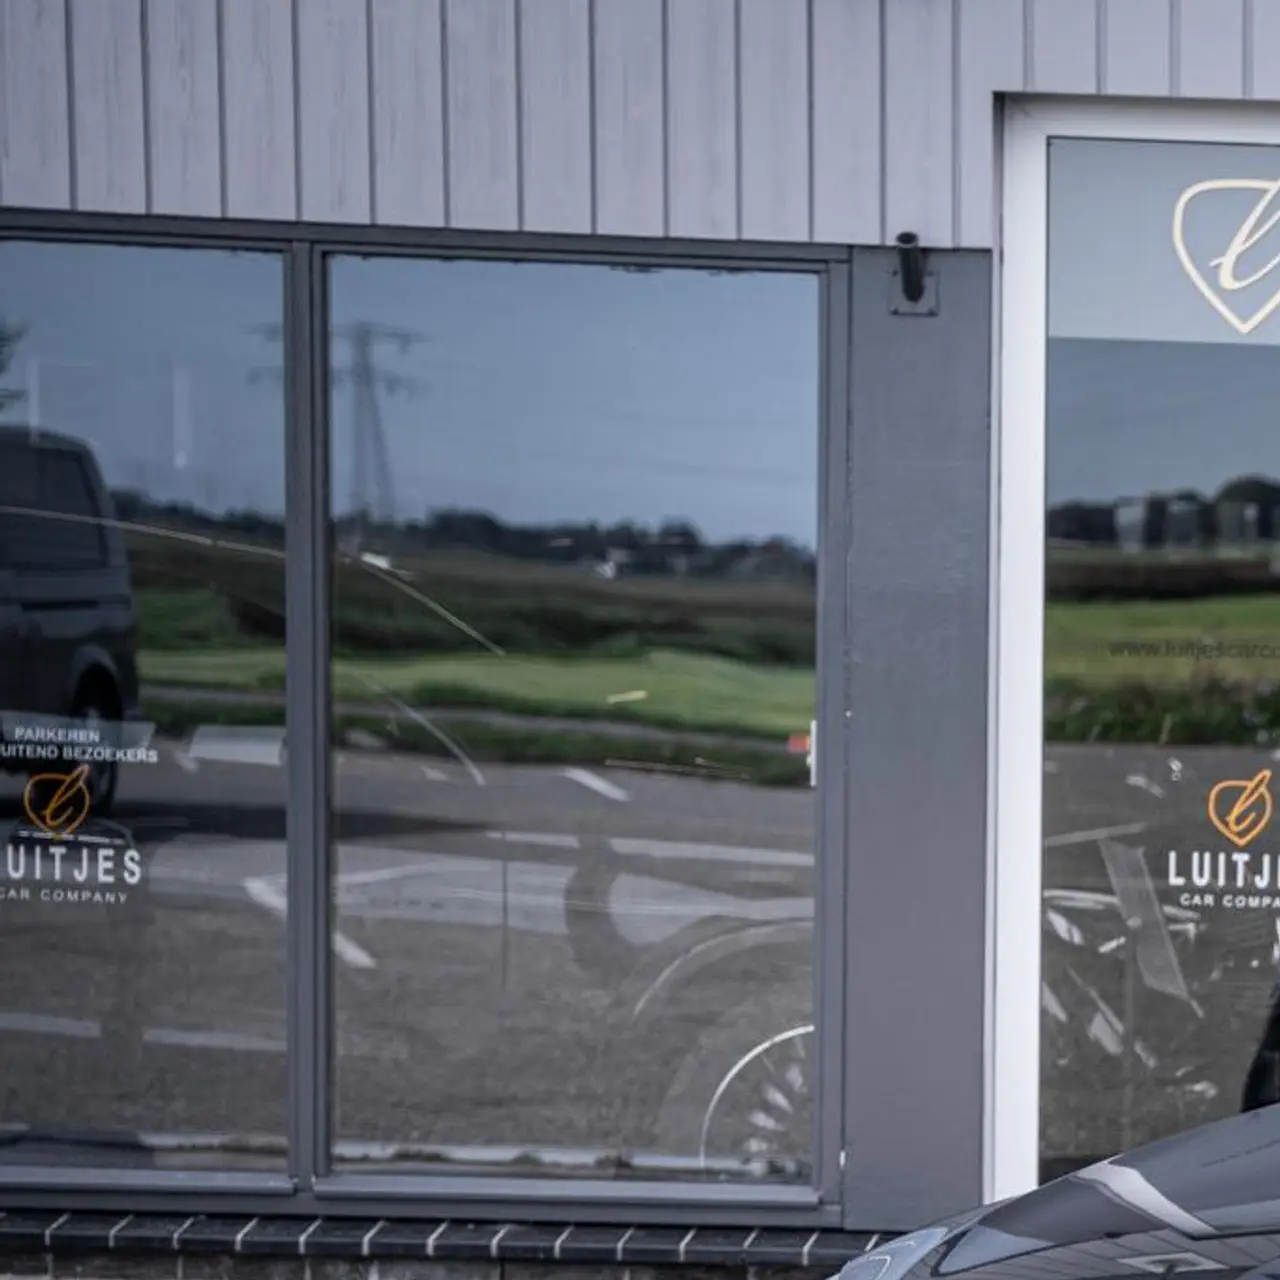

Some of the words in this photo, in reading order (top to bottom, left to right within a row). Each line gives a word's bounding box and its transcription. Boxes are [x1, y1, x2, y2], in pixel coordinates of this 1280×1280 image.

[15, 727, 100, 743] PARKEREN
[0, 745, 60, 759] UITEND
[62, 747, 158, 763] BEZOEKERS
[6, 844, 141, 885] UITJES
[40, 889, 128, 905] COMPANY
[1180, 892, 1215, 907] CAR
